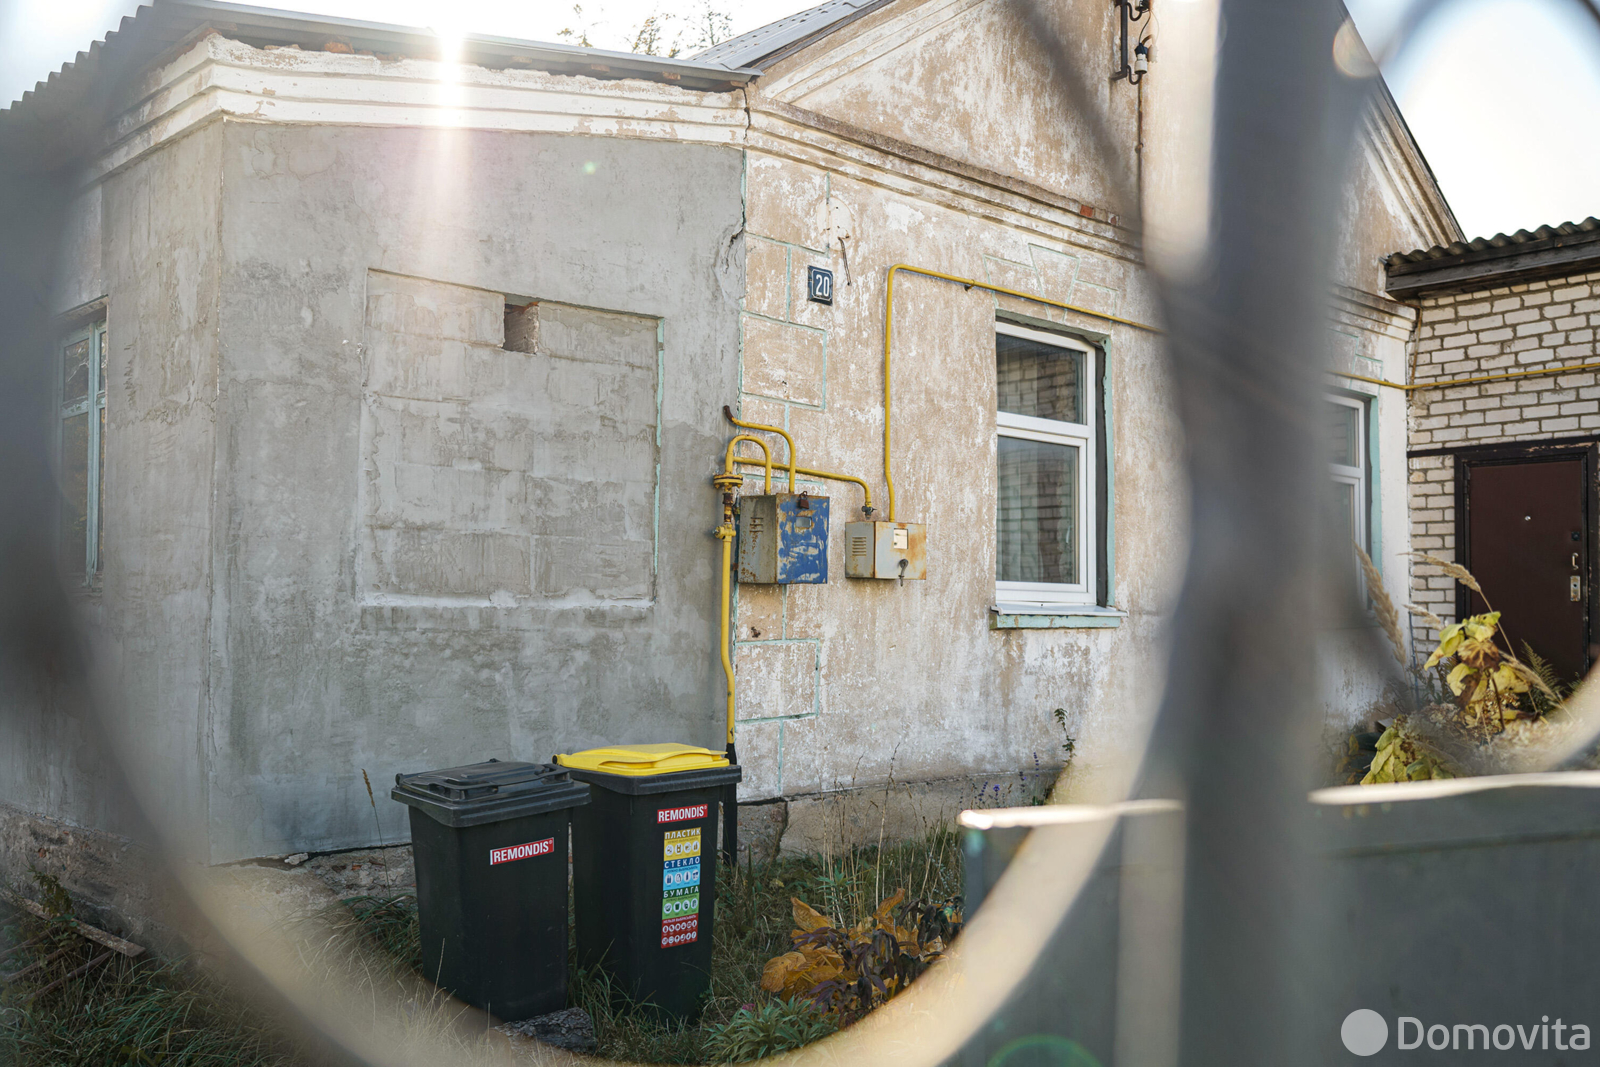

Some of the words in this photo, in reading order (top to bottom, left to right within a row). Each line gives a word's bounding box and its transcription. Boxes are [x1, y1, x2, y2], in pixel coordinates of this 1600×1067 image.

[815, 274, 830, 297] 20
[658, 806, 704, 822] REMONDIS
[665, 829, 701, 840] ПЛАСТИК
[493, 841, 549, 863] REMONDIS
[664, 856, 700, 869] СТЕКЛО
[663, 886, 699, 898] БУМАГА
